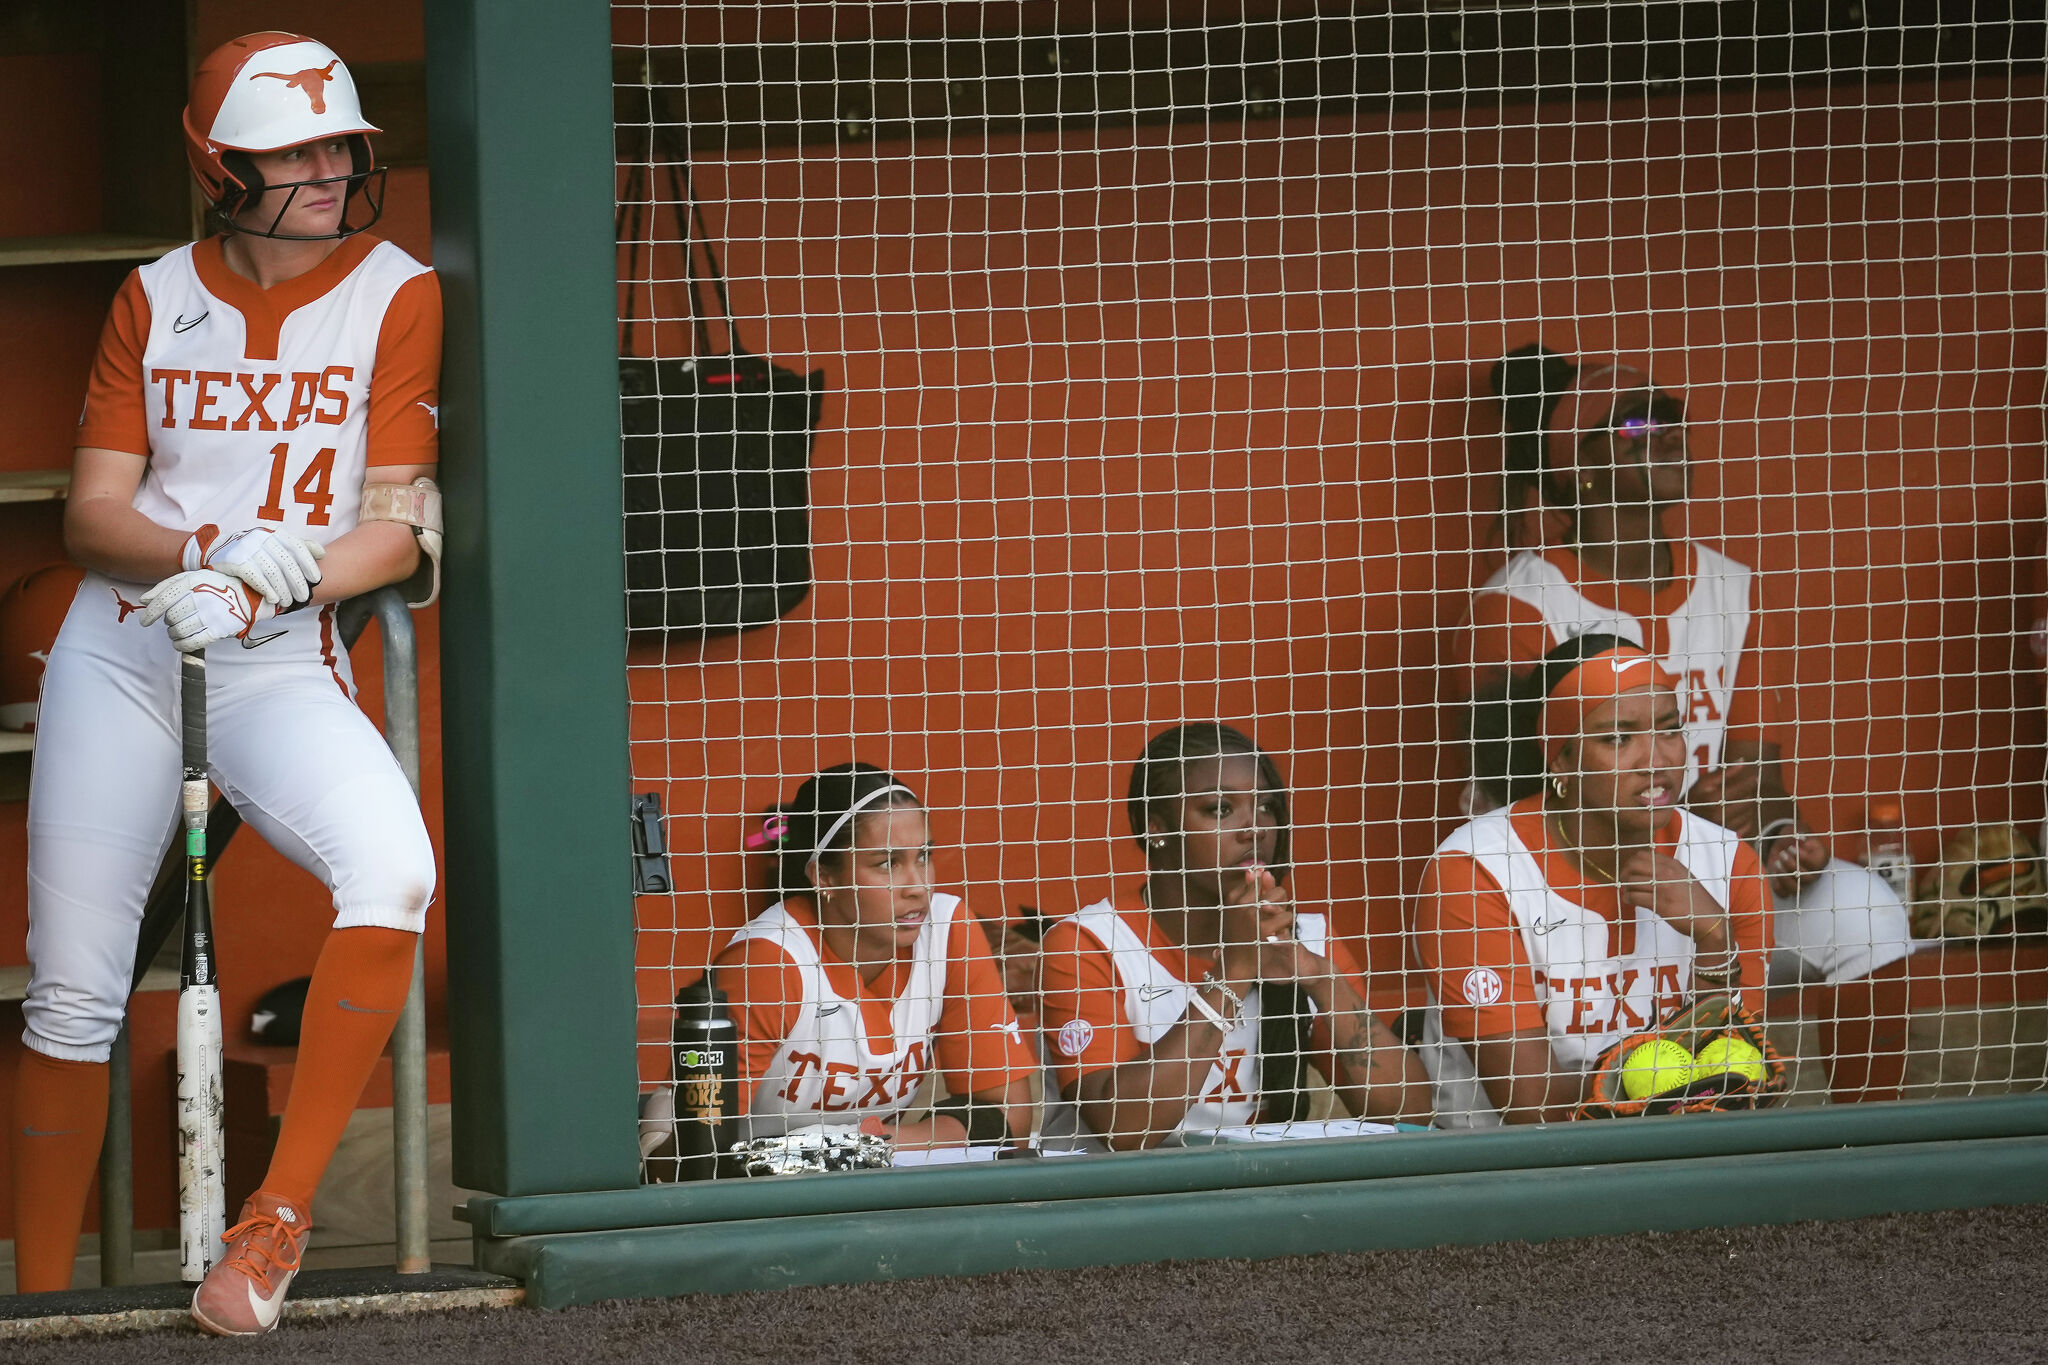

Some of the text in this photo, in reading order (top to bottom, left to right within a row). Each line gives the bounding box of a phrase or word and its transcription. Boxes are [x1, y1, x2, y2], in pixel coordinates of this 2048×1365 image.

[151, 366, 354, 431] TEXAS
[257, 443, 337, 526] 14
[1465, 969, 1500, 1005] SEC
[1535, 965, 1683, 1035] TEXA
[686, 1089, 724, 1105] OKC
[778, 1026, 937, 1112] TEXA
